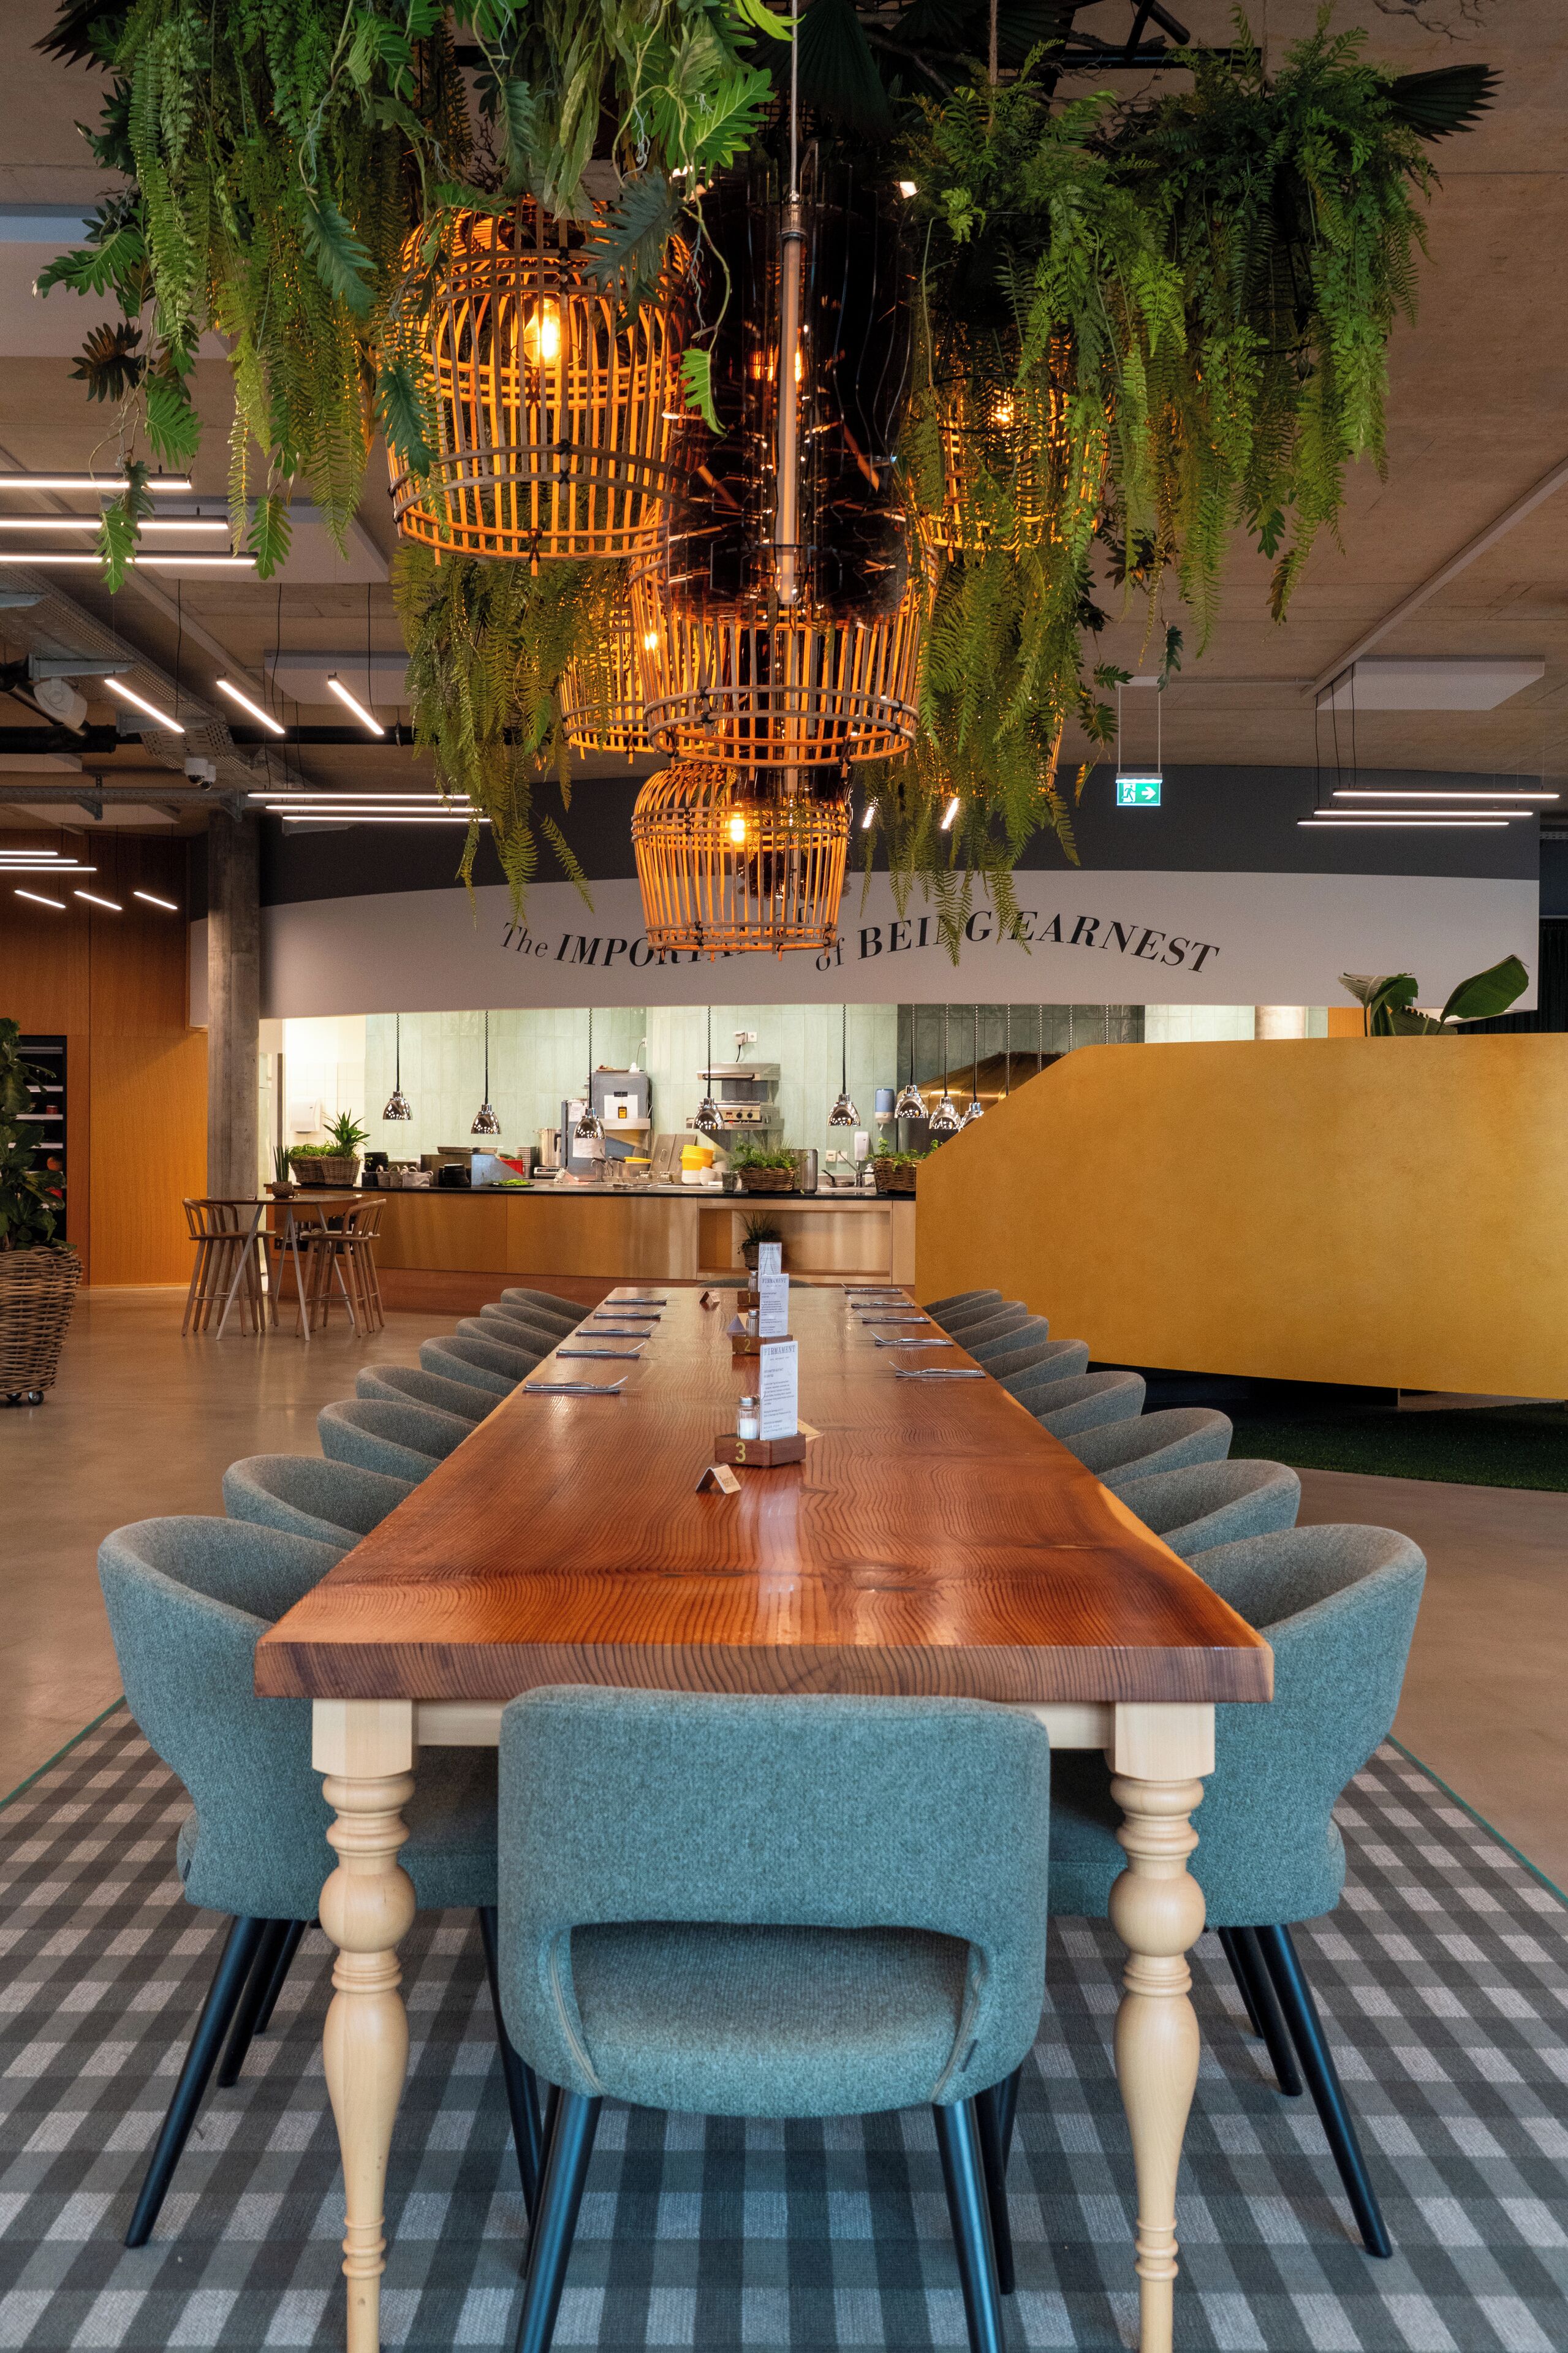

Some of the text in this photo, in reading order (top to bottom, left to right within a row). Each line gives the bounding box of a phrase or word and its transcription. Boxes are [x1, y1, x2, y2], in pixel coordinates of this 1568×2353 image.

[500, 922, 548, 958] The
[816, 937, 845, 971] of
[857, 911, 992, 960] BEIG
[1007, 911, 1220, 973] EARNEST
[747, 1292, 751, 1303] 1
[744, 1338, 751, 1352] 2
[764, 1344, 795, 1355] FIRMAMENT
[735, 1441, 746, 1462] 3
